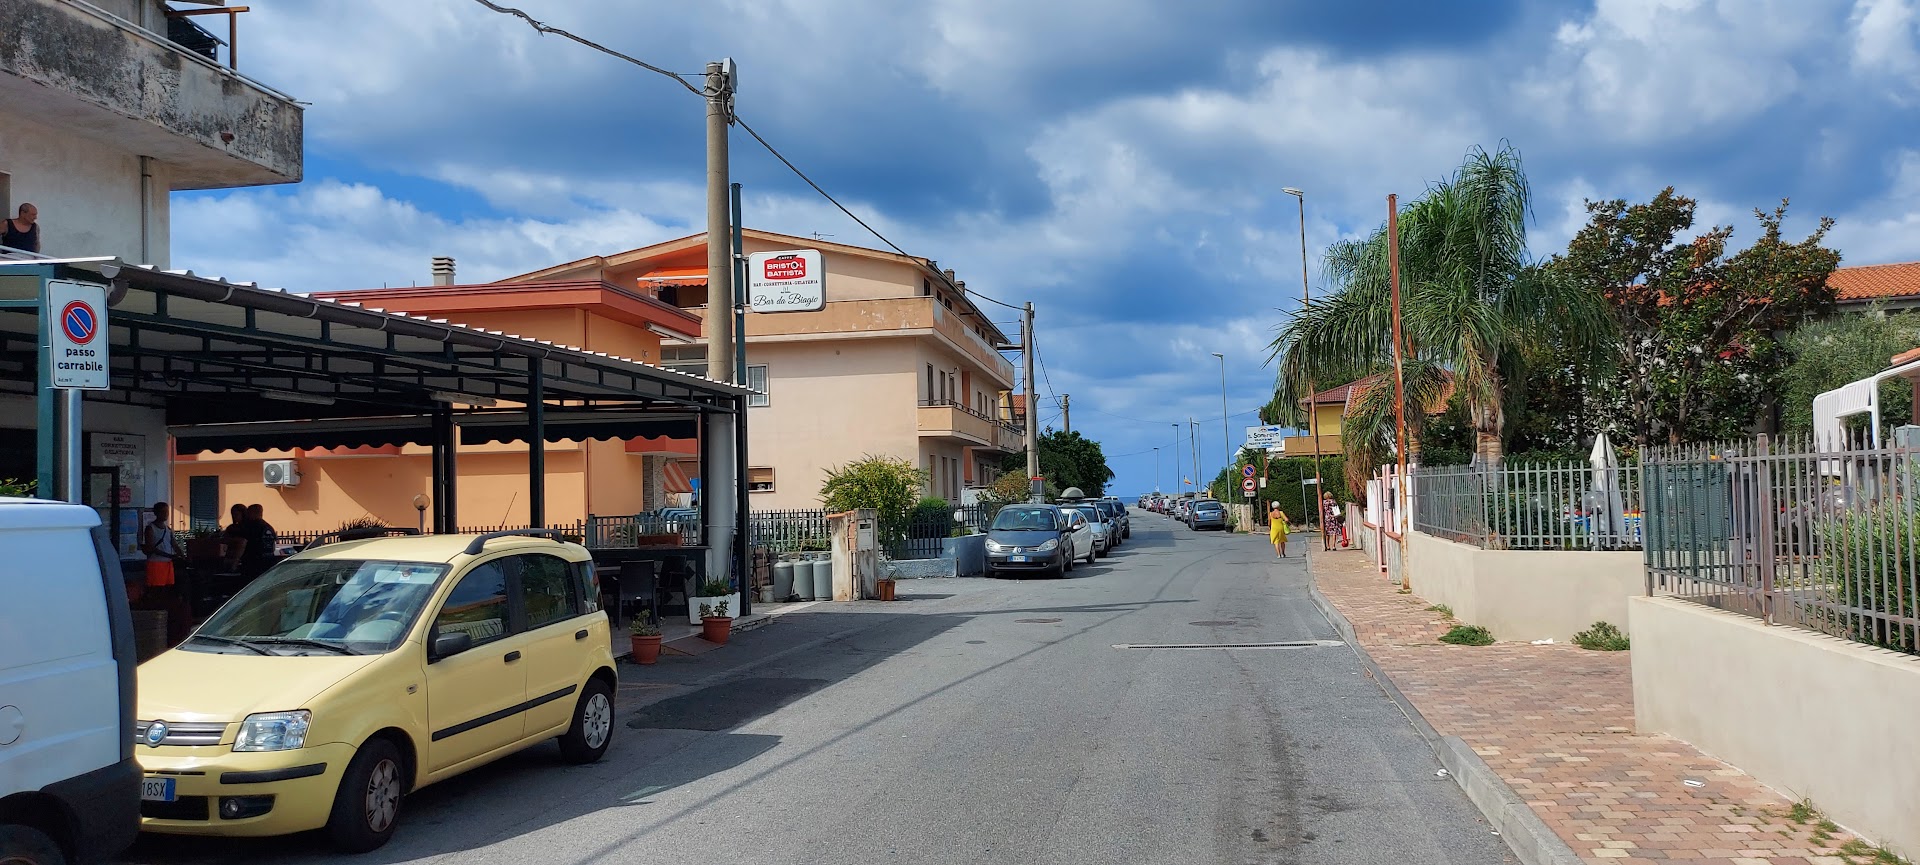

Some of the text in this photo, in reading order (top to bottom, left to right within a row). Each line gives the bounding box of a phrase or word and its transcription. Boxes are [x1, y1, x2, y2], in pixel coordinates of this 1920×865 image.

[767, 261, 804, 270] BRISTOL
[767, 269, 804, 277] BATTISTA
[754, 293, 819, 307] Bar da Biagio
[66, 348, 96, 357] passo
[58, 361, 103, 371] carrabile
[142, 782, 166, 797] 18SX
